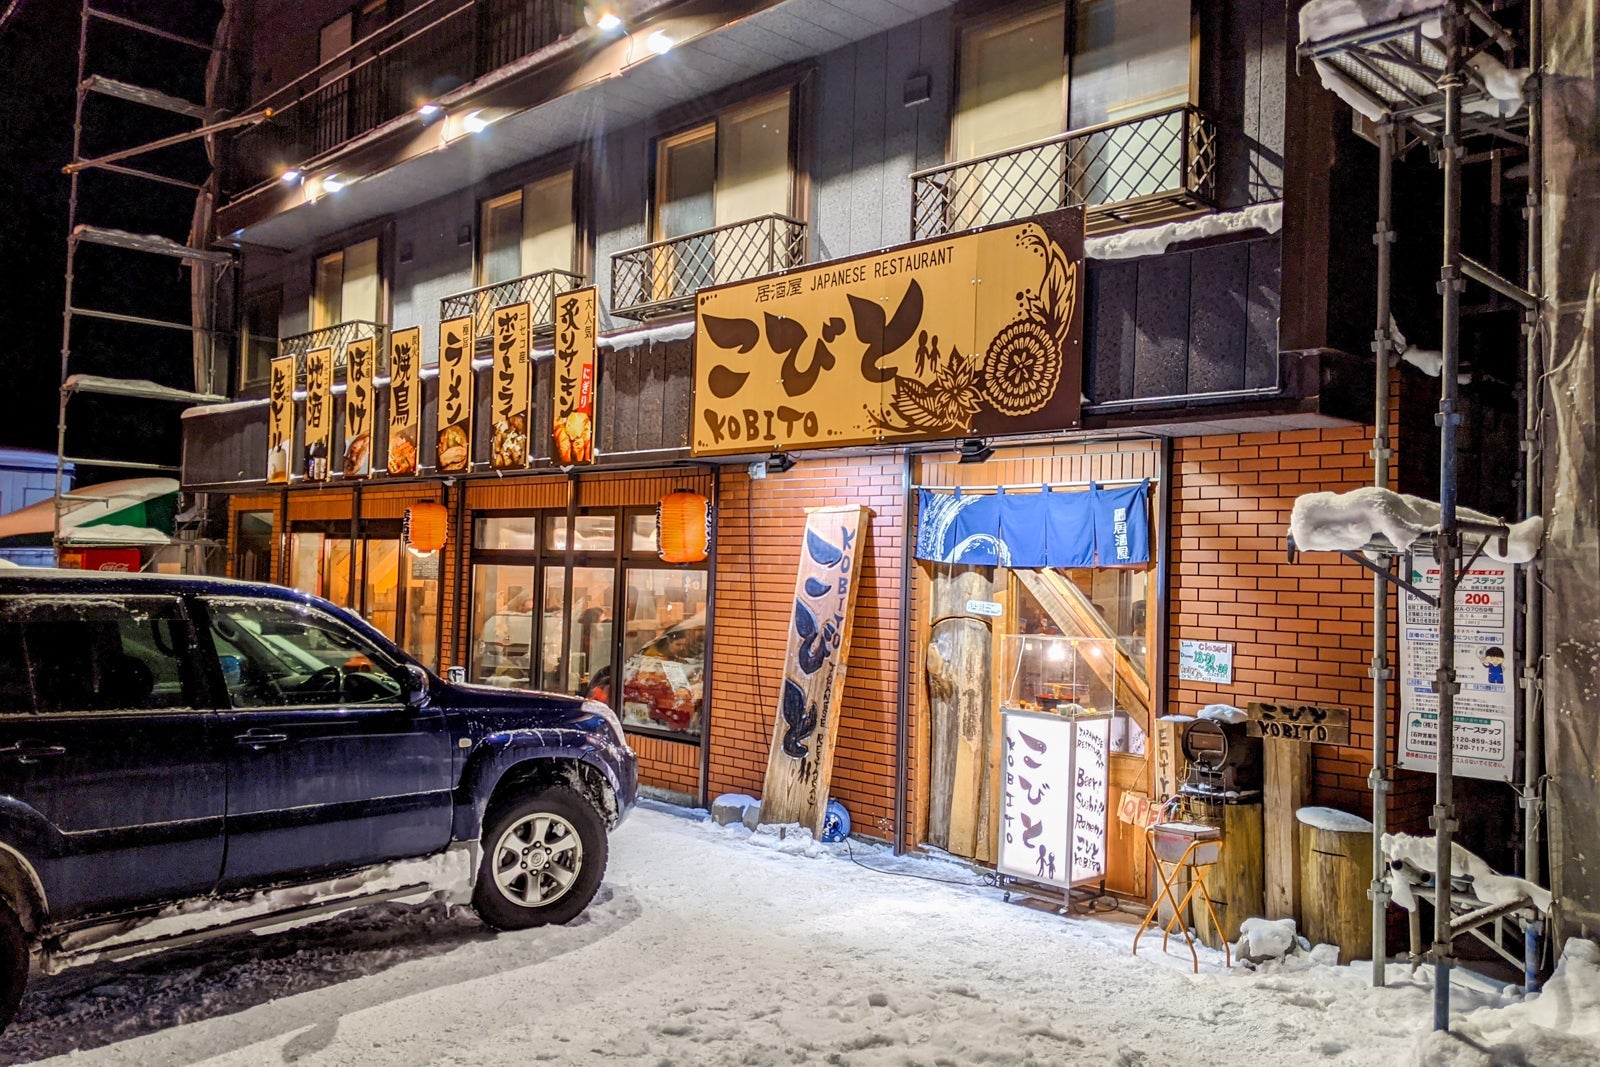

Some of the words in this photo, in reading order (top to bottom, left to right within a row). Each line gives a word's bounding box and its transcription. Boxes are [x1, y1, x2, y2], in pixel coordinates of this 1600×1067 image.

[755, 277, 802, 302] 居酒屋
[811, 265, 866, 291] JAPANESE
[874, 246, 954, 278] RESTAURANT
[559, 297, 580, 418] 炙りサーモン
[584, 297, 593, 339] 大人気
[701, 278, 924, 399] こびと
[308, 354, 324, 428] 地酒
[348, 347, 367, 436] ほっけ
[391, 342, 411, 426] 焼鳥
[445, 331, 463, 425] ラーメン
[498, 312, 518, 421] ポテトフライ
[581, 368, 591, 409] にぎり
[271, 367, 287, 453] 生ビール
[704, 405, 819, 444] KOBITO
[831, 525, 856, 650] KOBITO
[1465, 593, 1490, 605] 200
[781, 526, 844, 760] こびと
[1158, 728, 1169, 803] Entra
[1257, 721, 1328, 741] KOBITO
[1004, 736, 1015, 844] KOBITO
[1018, 729, 1050, 849] こびと
